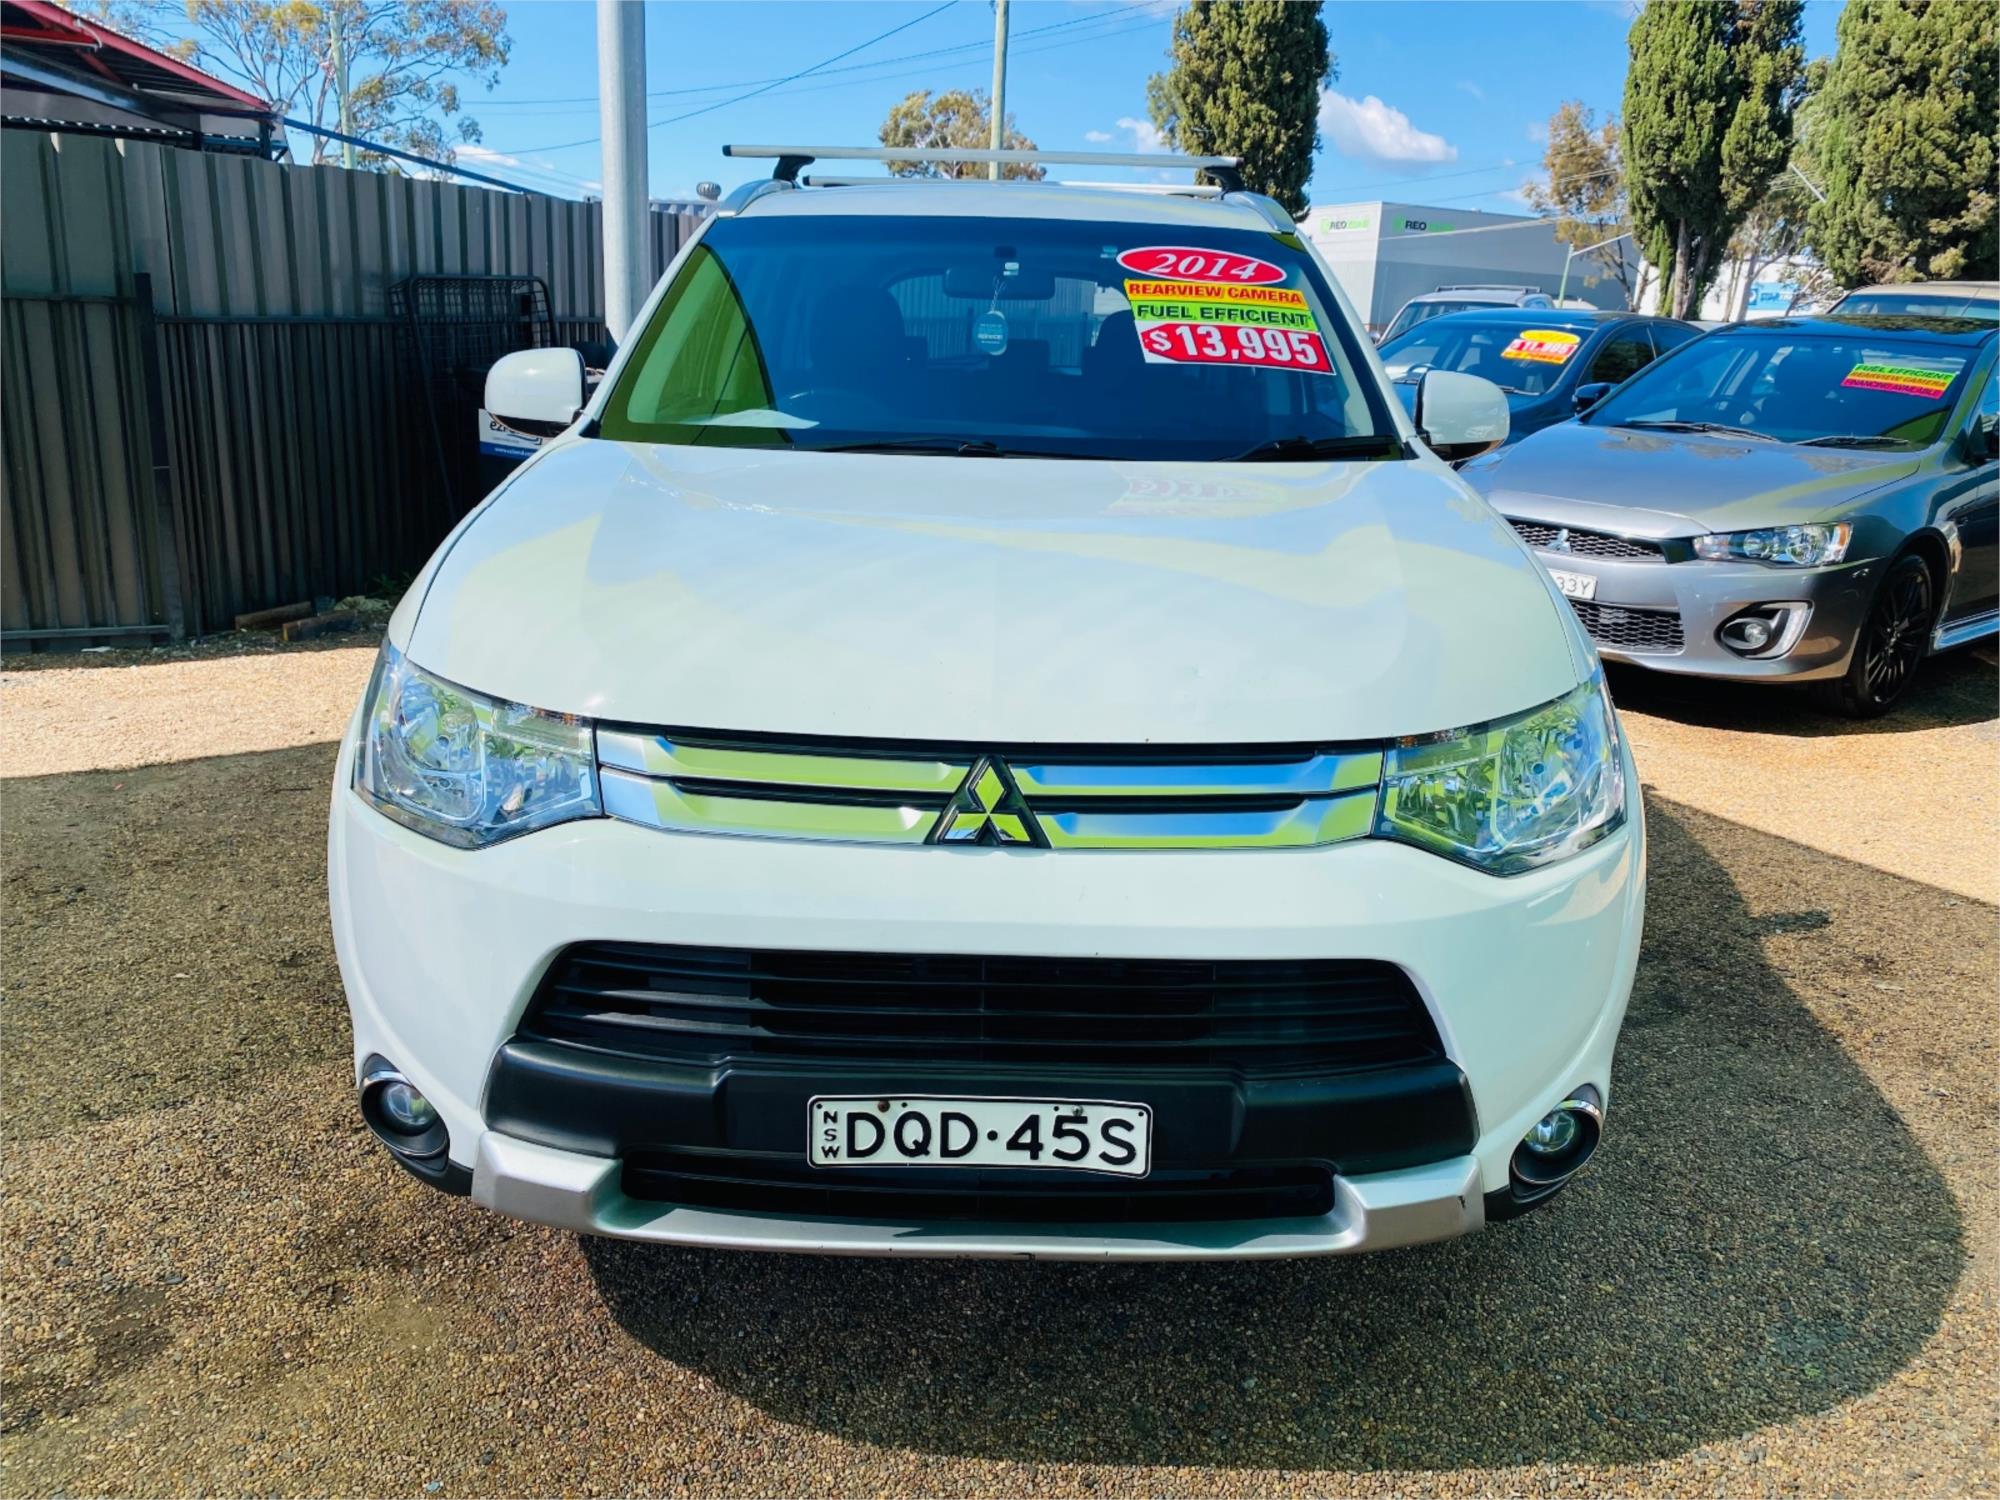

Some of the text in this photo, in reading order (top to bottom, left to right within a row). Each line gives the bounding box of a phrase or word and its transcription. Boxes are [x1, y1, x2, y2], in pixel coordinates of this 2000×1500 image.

[1405, 220, 1427, 231] REO
[1148, 253, 1261, 280] 2014
[1129, 283, 1302, 304] REARVIEW CAMERA
[1137, 304, 1309, 326] FUEL EFFICIENT
[1150, 325, 1318, 365] $13,995
